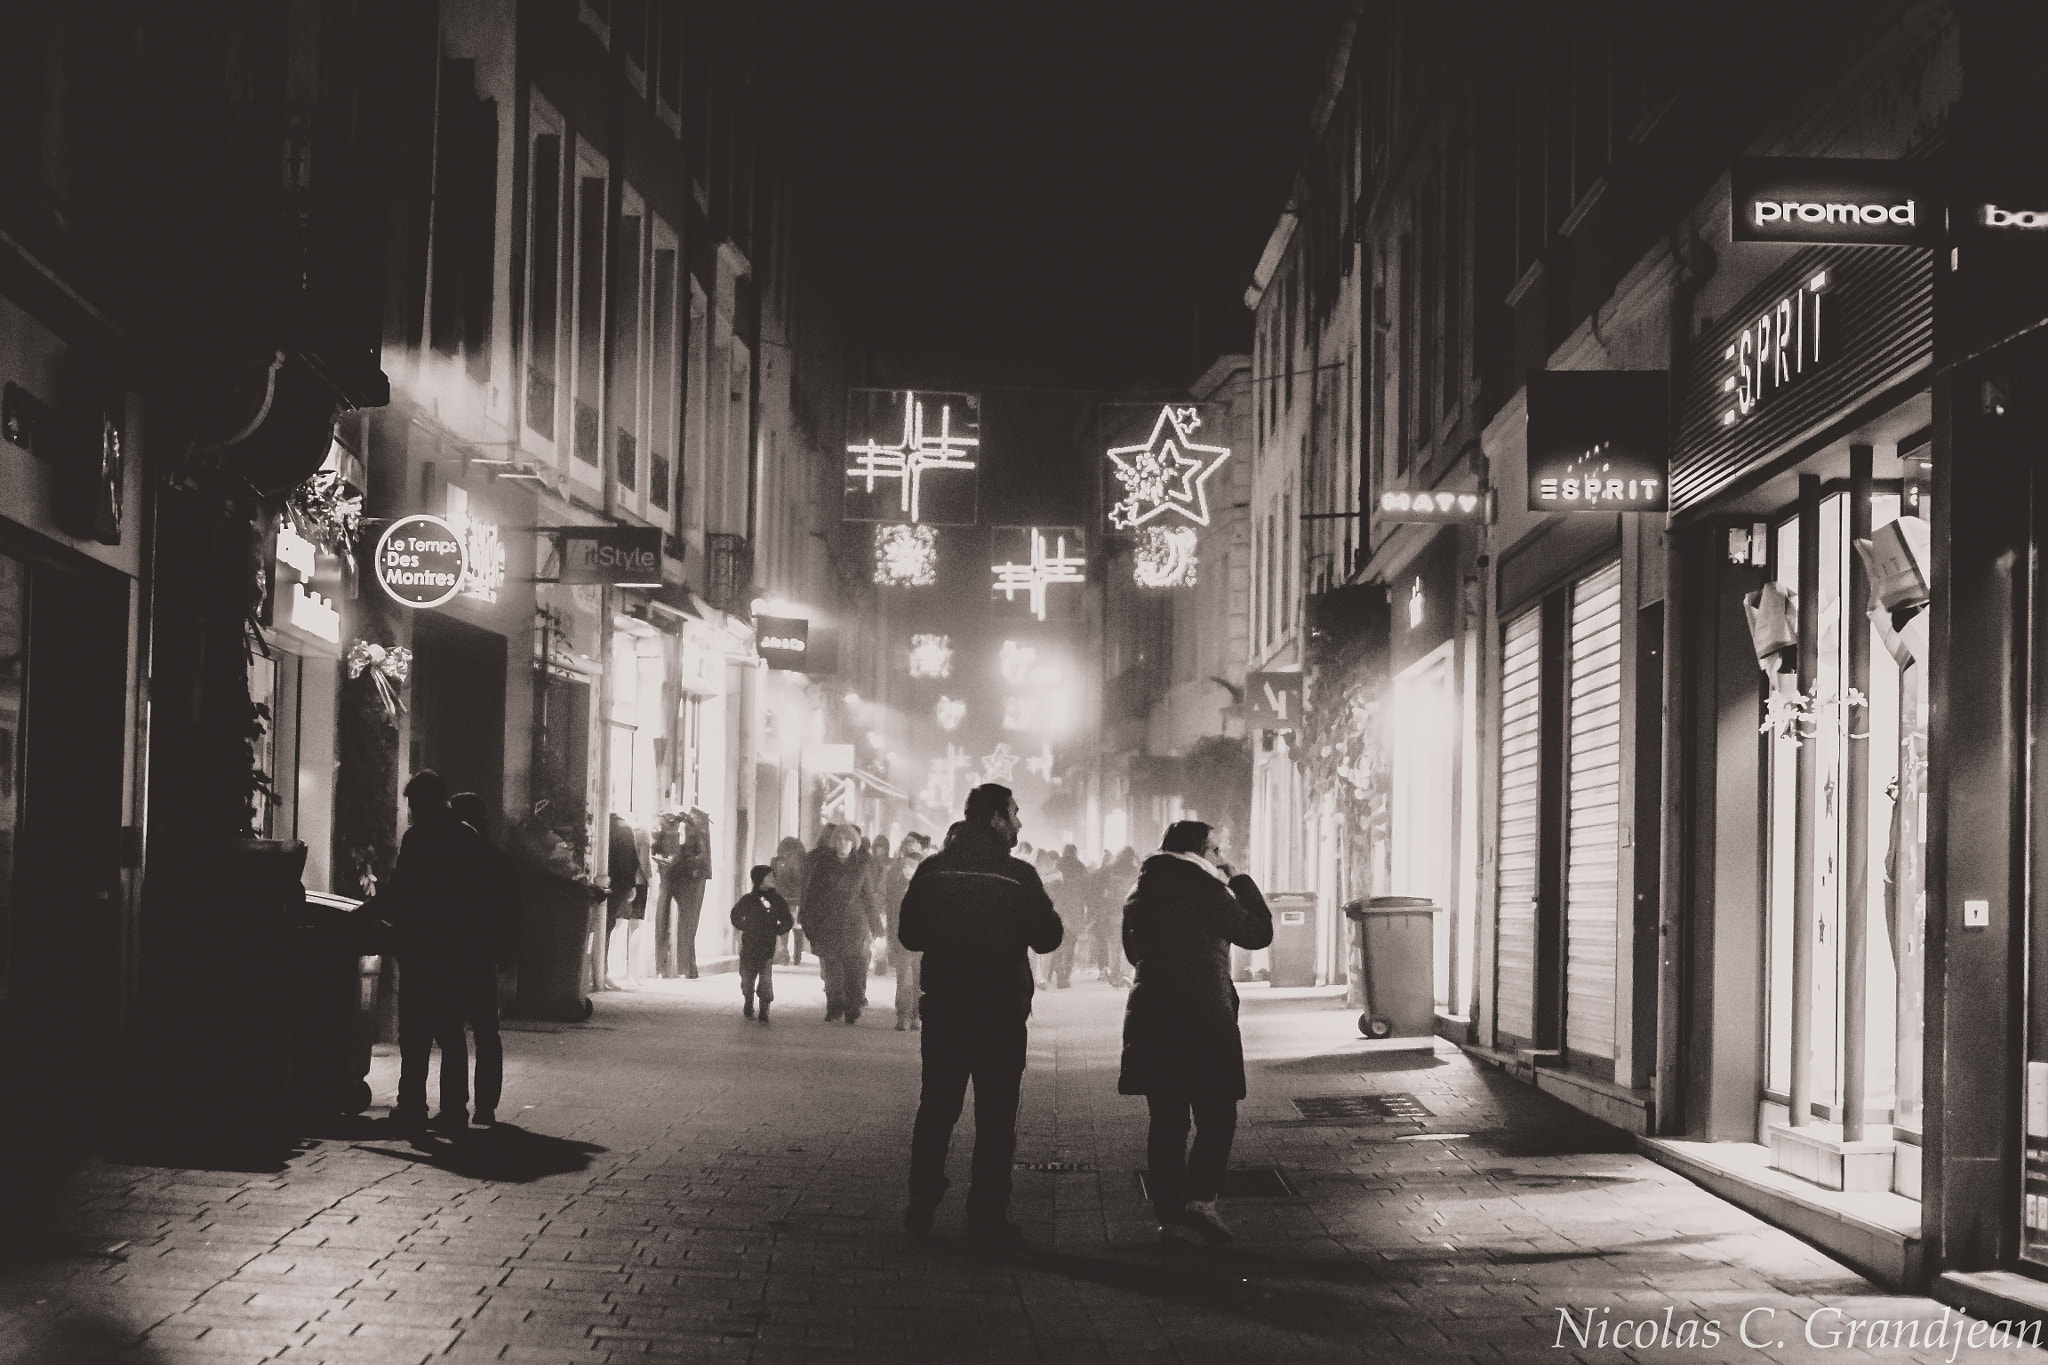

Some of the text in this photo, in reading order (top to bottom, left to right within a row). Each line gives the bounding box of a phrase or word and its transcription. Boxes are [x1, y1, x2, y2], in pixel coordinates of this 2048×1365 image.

[1755, 200, 1915, 226] promod
[1724, 271, 1826, 425] ESPRIT
[1540, 478, 1659, 501] ESPRIT
[387, 537, 457, 555] Le Temps
[386, 552, 420, 568] Des
[386, 568, 456, 587] Montres
